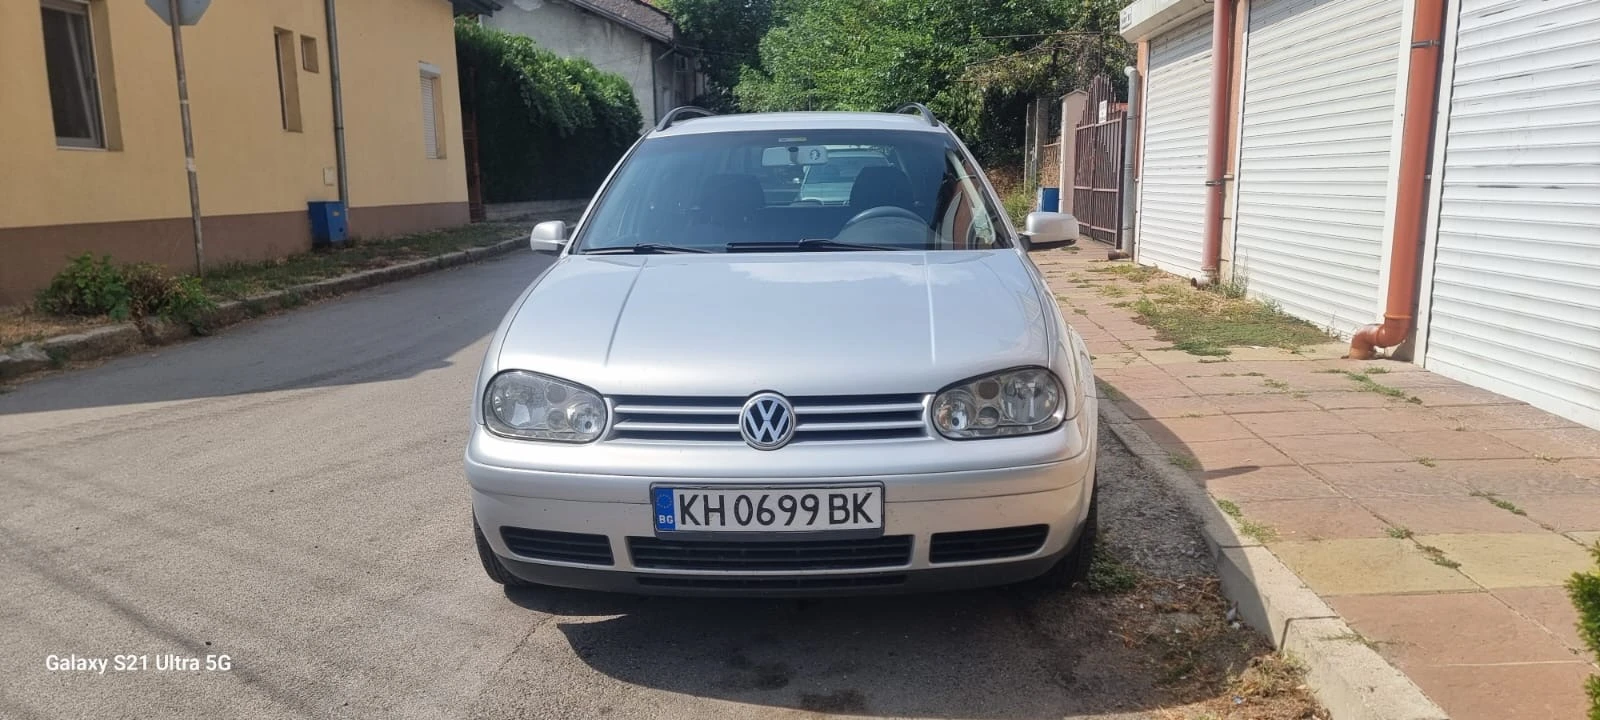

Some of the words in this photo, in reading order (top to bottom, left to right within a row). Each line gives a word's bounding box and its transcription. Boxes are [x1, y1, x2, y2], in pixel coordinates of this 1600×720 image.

[742, 395, 792, 444] VW
[658, 514, 674, 524] BG
[679, 494, 726, 526] KH
[734, 494, 820, 526] 0699
[828, 492, 874, 525] BK
